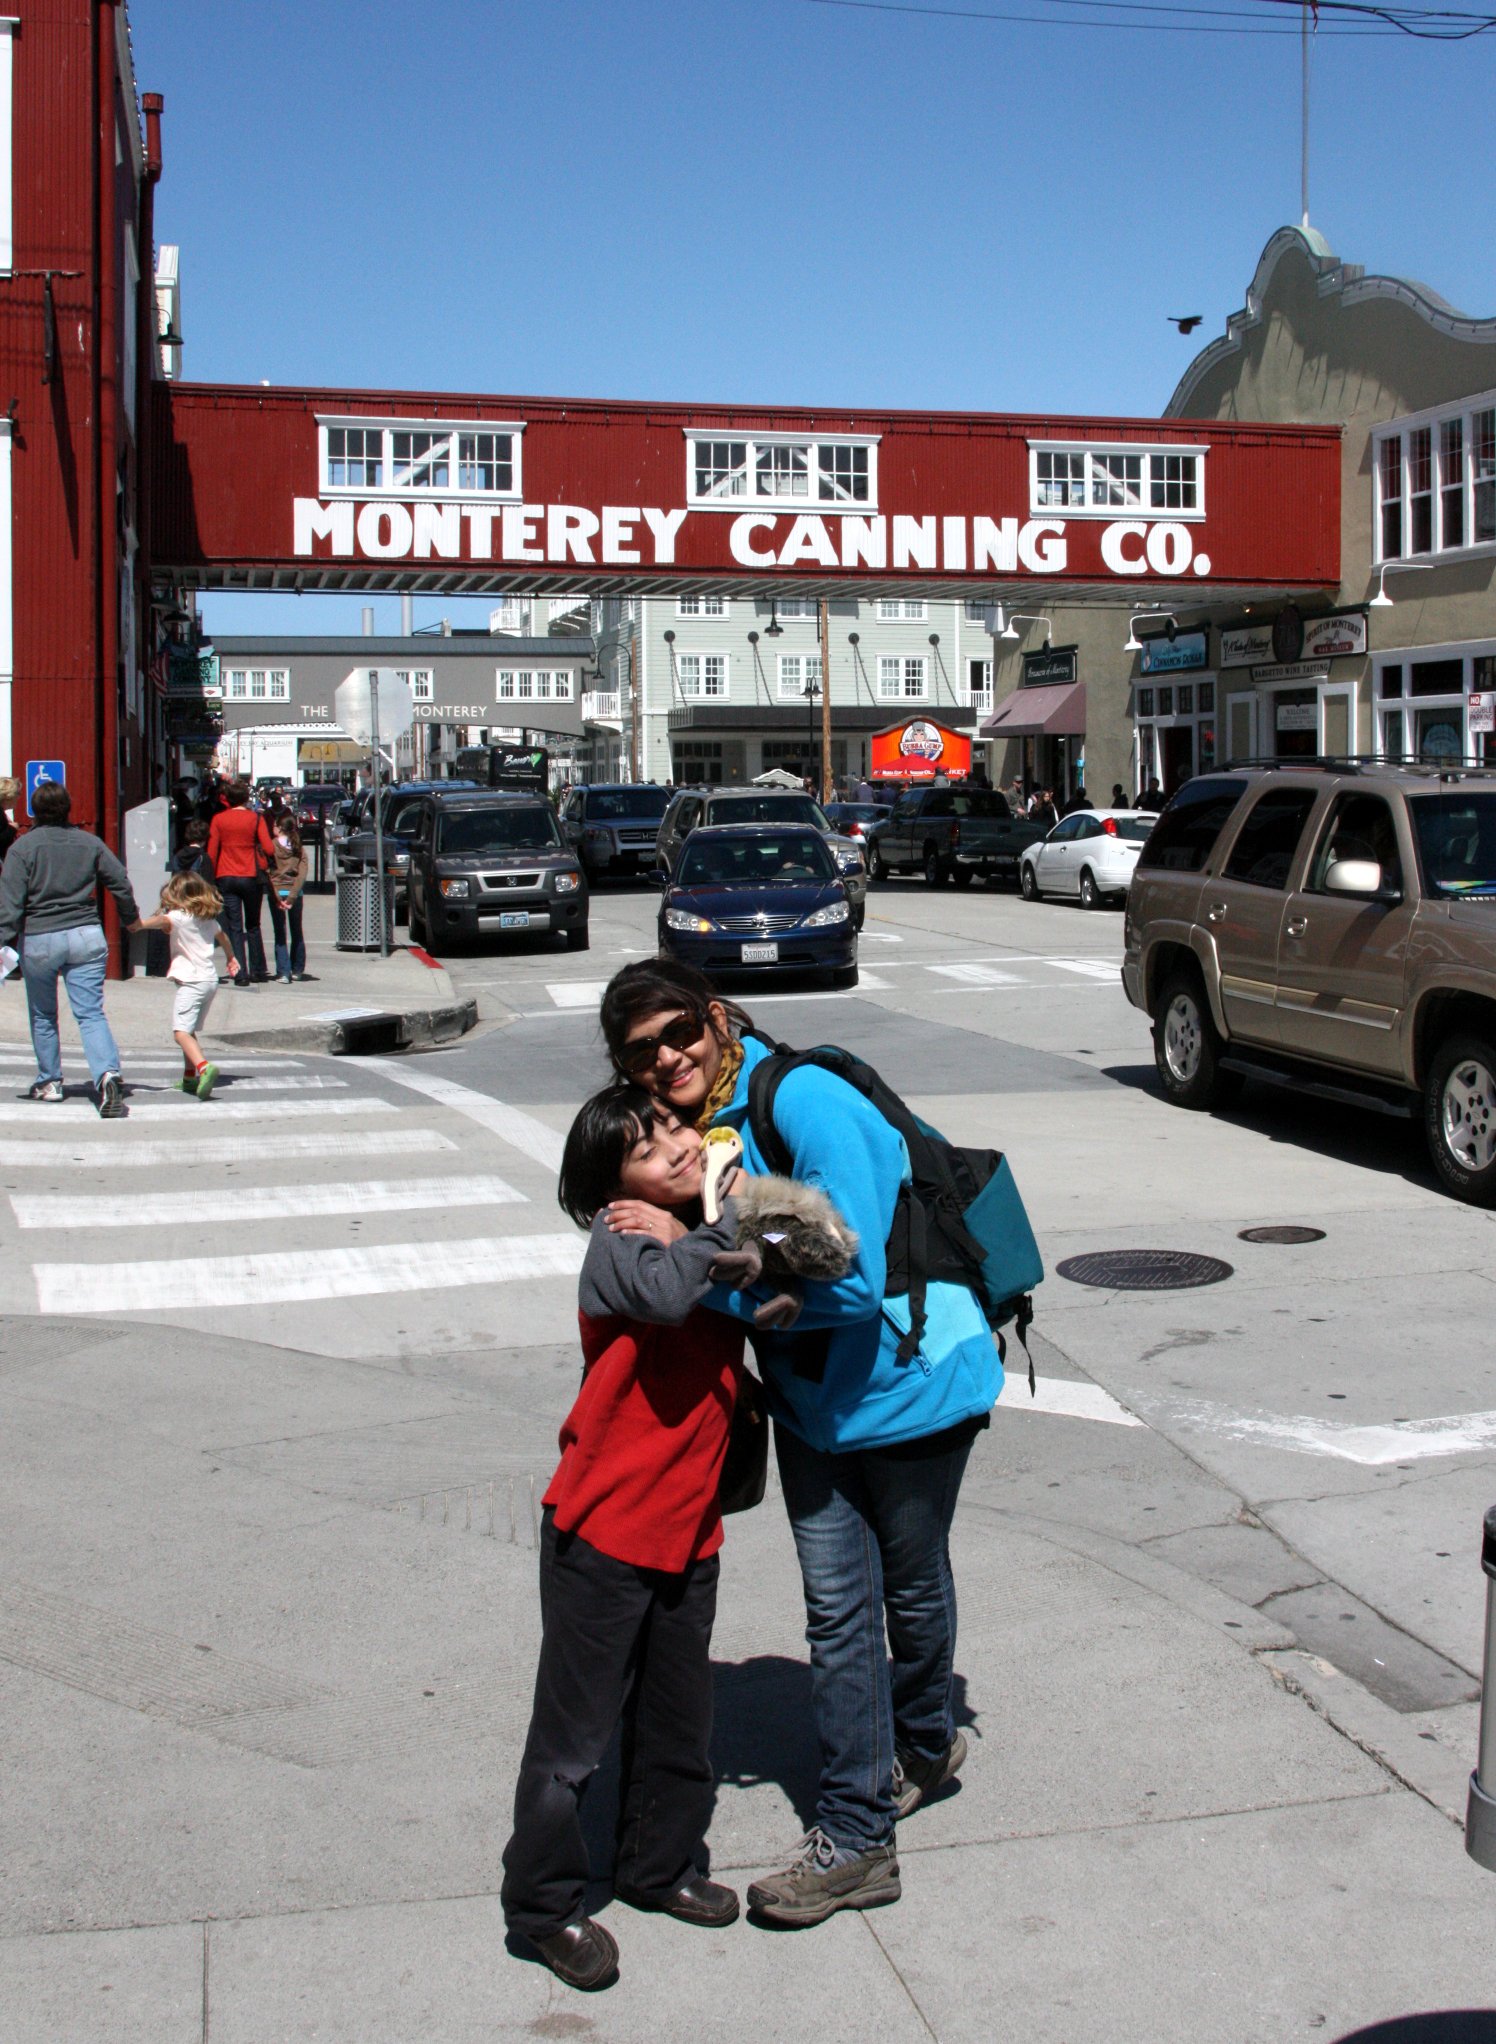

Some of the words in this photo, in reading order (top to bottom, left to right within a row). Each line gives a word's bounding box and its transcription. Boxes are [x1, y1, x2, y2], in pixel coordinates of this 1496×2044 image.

[293, 498, 687, 563] MONTEREY
[729, 512, 1067, 572] CANNING
[1101, 521, 1211, 575] CO.
[1306, 625, 1324, 643] SPIRIT
[1323, 622, 1332, 631] OF
[1331, 619, 1362, 637] MONTEREY
[1285, 665, 1300, 675] WINE
[1302, 663, 1328, 674] TASTING
[1470, 696, 1480, 704] NO
[301, 705, 328, 717] THE
[412, 705, 487, 717] MONTEREY
[1470, 706, 1492, 714] DOUBLE
[924, 742, 942, 750] GUMP
